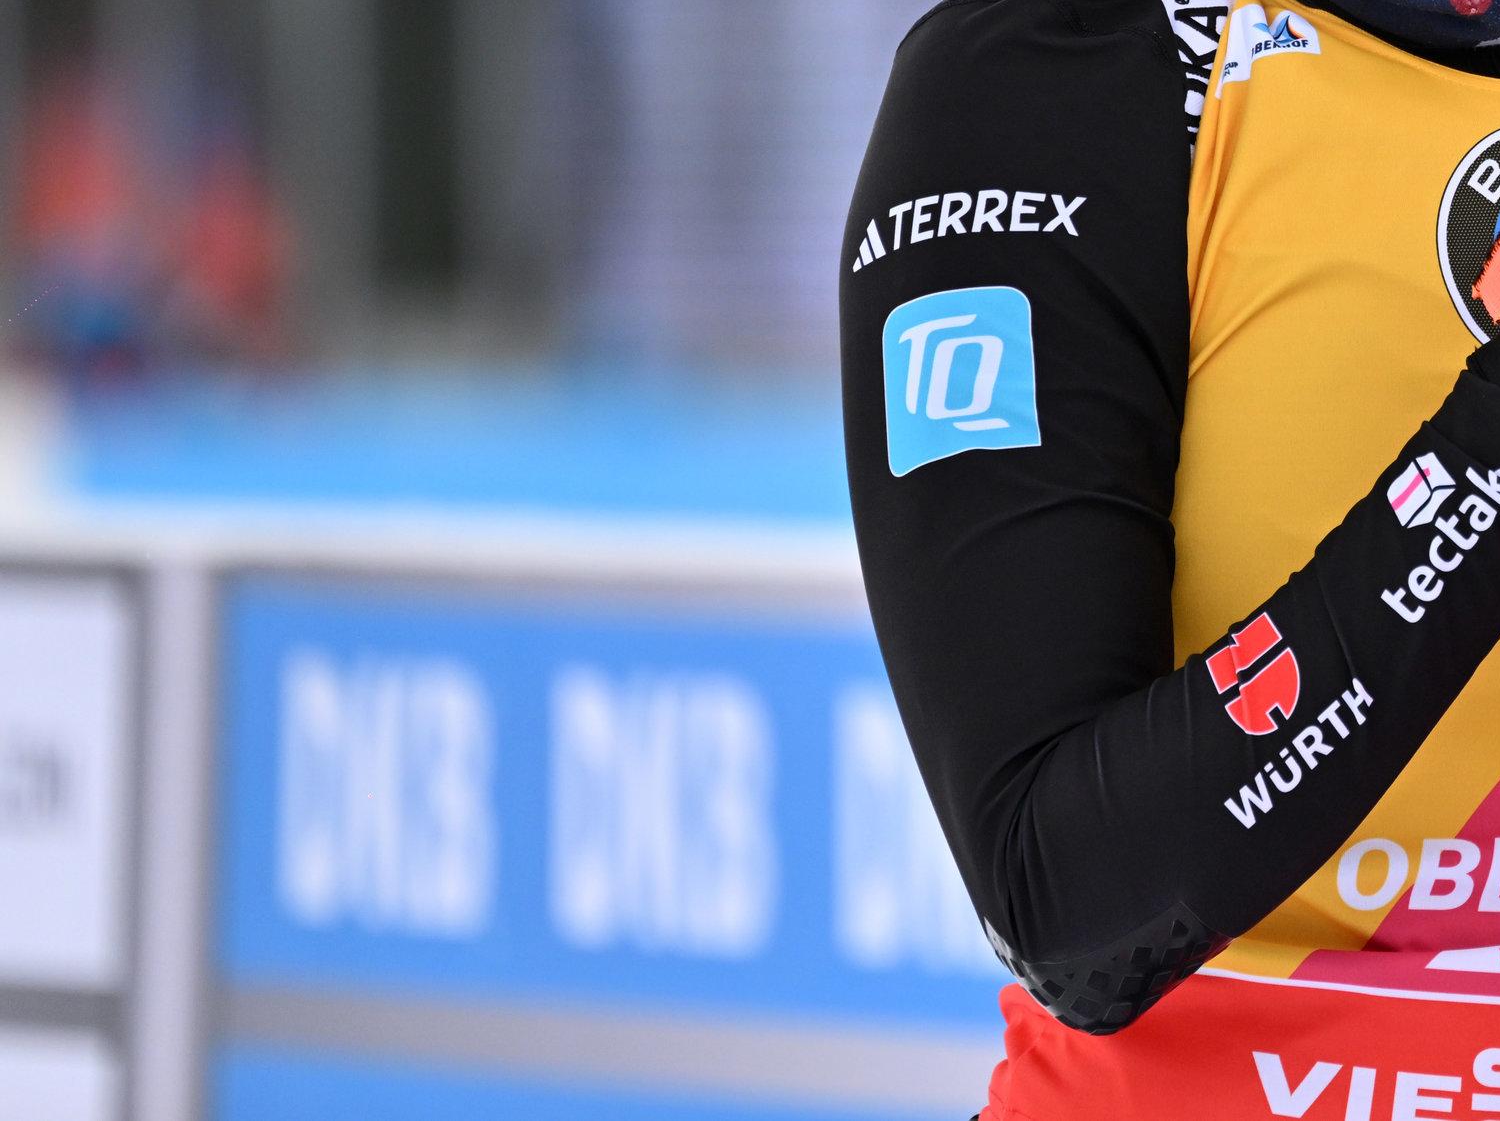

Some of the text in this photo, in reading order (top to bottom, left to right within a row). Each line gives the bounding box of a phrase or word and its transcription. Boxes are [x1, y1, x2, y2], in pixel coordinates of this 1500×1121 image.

[888, 189, 1088, 251] TERREX
[898, 314, 1011, 432] TQ
[1224, 678, 1375, 829] WÜRTH
